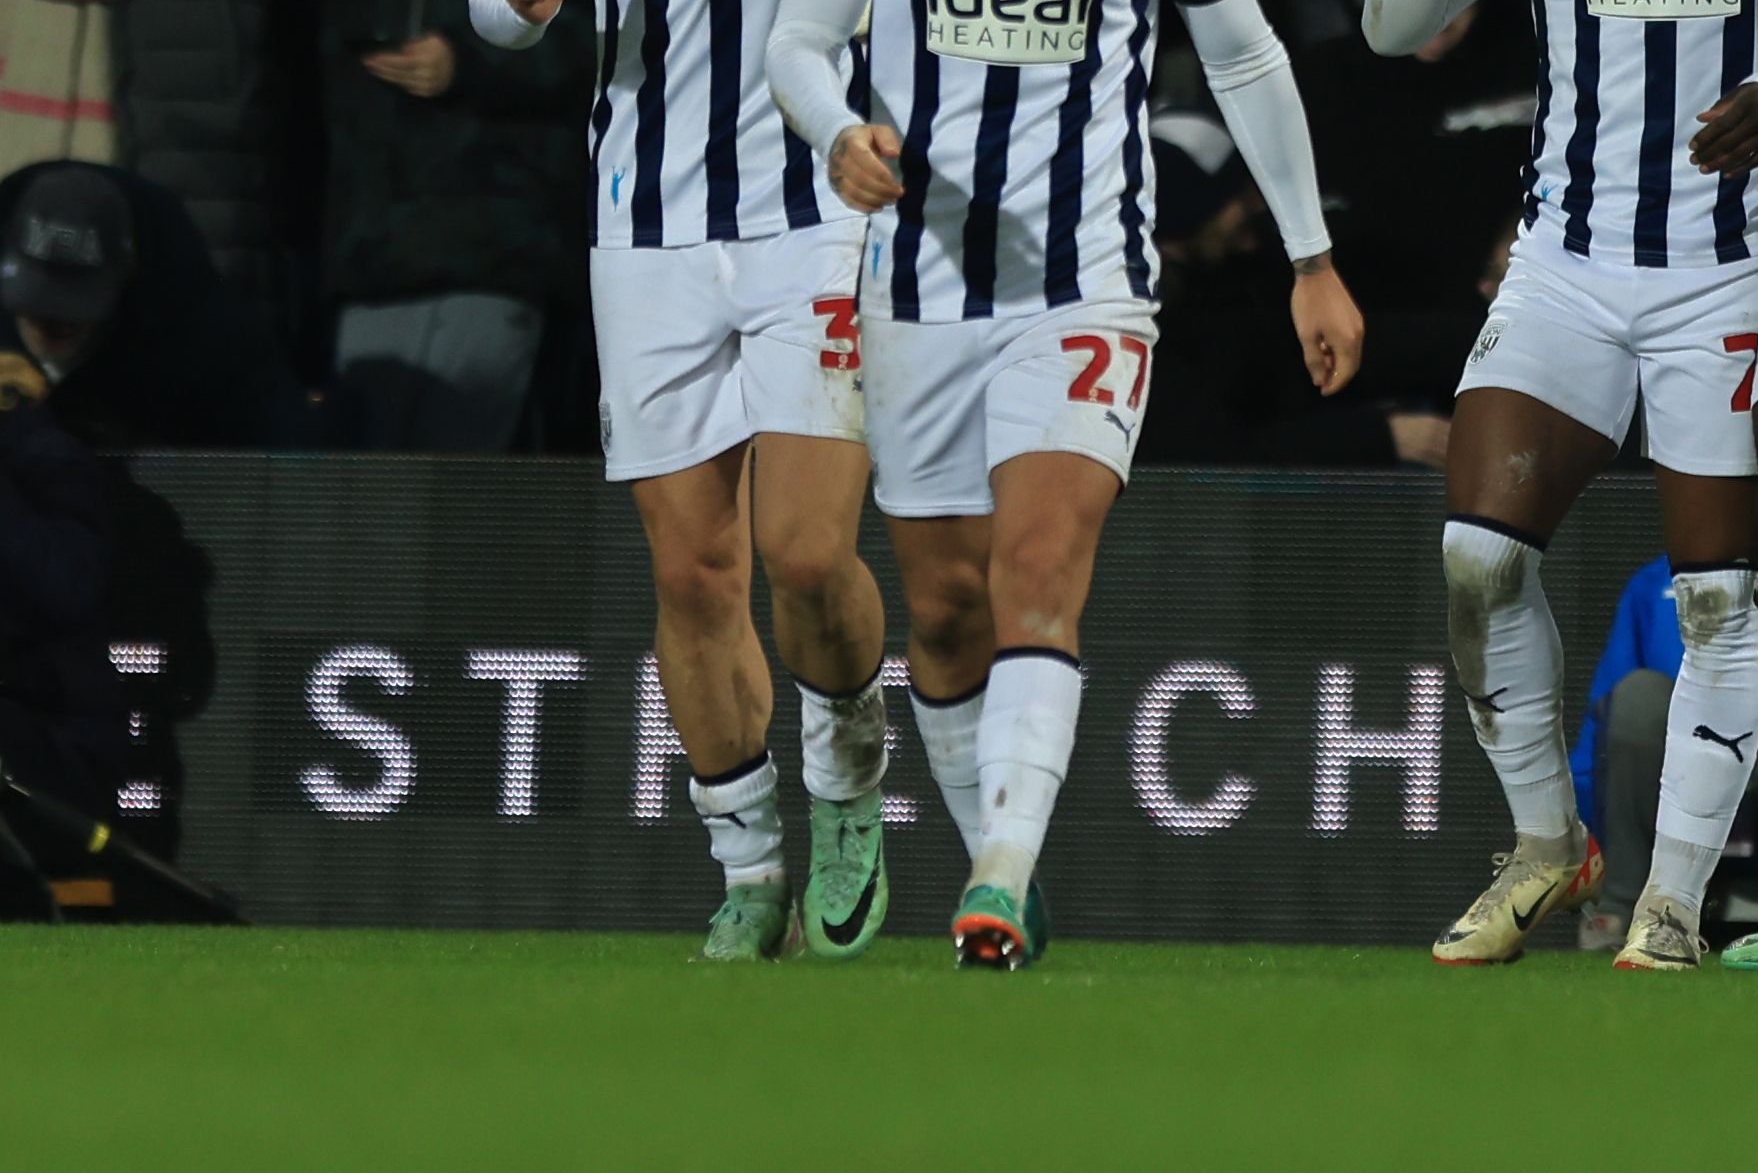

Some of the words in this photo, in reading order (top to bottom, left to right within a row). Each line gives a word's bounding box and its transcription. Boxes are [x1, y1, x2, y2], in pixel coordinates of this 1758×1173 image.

[927, 20, 1086, 53] HEATING
[1060, 334, 1149, 412] 27
[300, 642, 1447, 840] STCH
